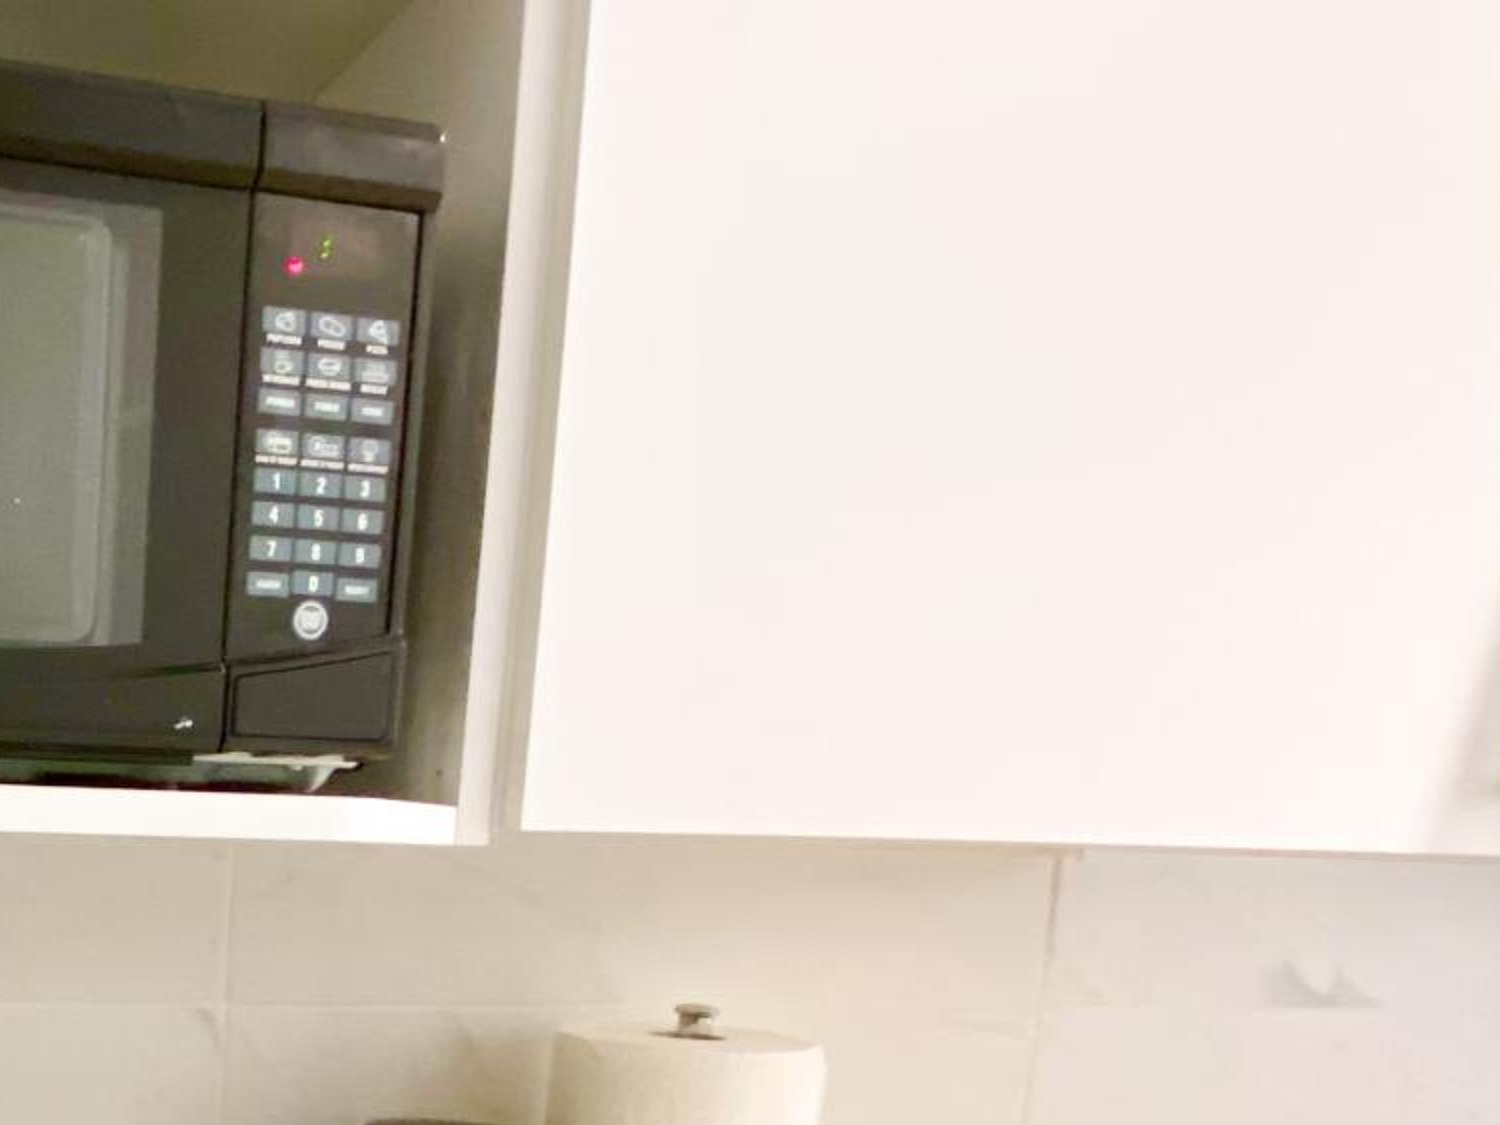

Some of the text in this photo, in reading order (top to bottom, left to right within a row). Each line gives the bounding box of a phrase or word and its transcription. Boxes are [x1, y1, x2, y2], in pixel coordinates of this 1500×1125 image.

[272, 472, 371, 498] 1 2 3
[268, 505, 368, 531] 4 5 6
[266, 540, 277, 557] 7
[308, 575, 319, 593] 0
